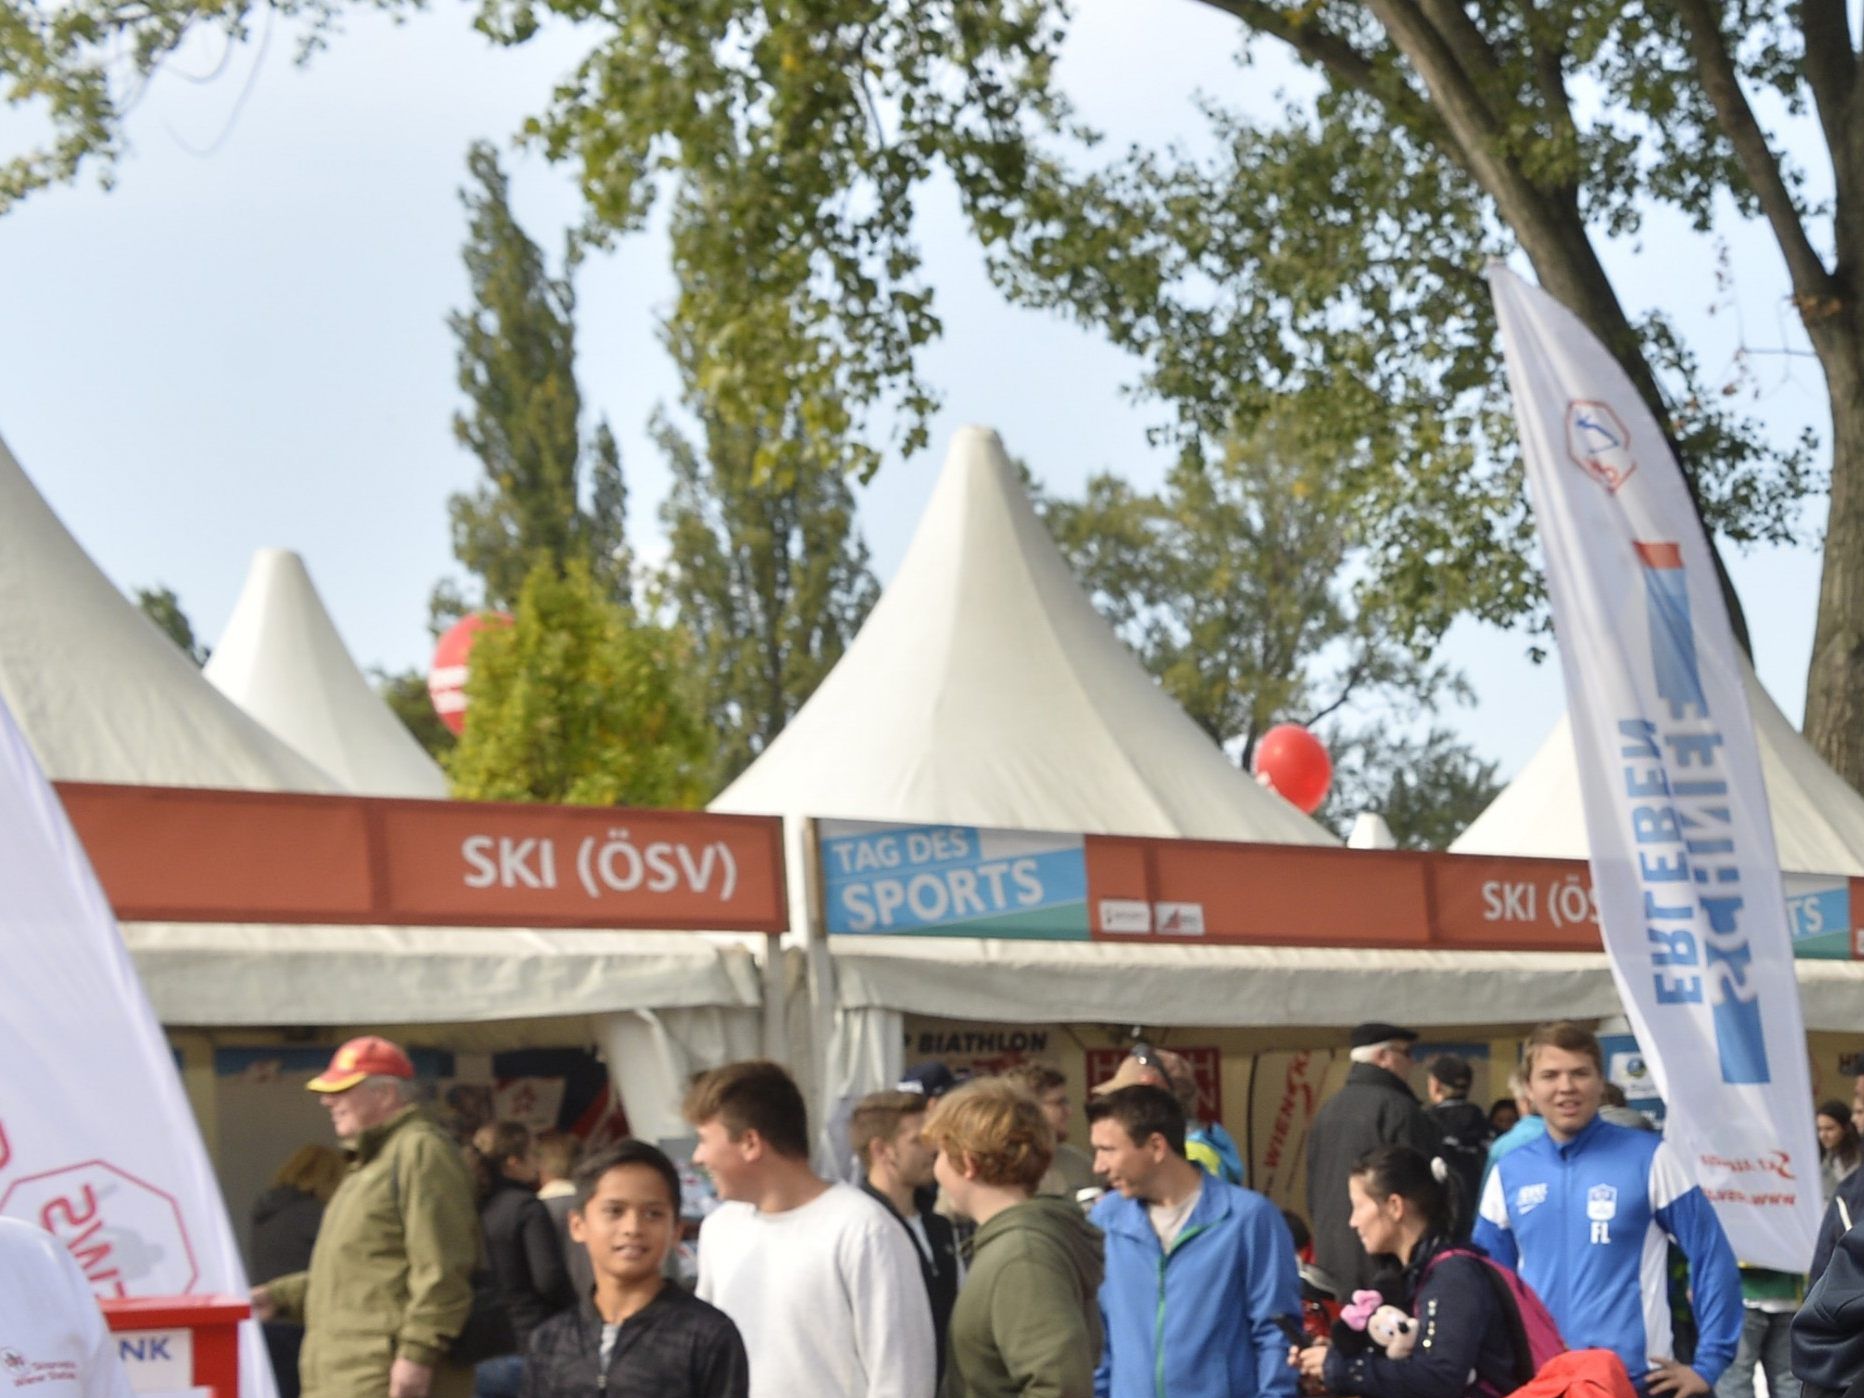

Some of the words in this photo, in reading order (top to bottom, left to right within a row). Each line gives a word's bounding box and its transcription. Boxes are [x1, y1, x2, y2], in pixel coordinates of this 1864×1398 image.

[460, 836, 556, 890] SKI
[577, 829, 738, 901] (ÖSV)
[833, 840, 899, 875] TAG
[907, 831, 970, 865] DES
[842, 860, 1044, 932] SPORTS
[1481, 880, 1537, 922] SKI
[917, 1031, 1047, 1053] BIATHLON
